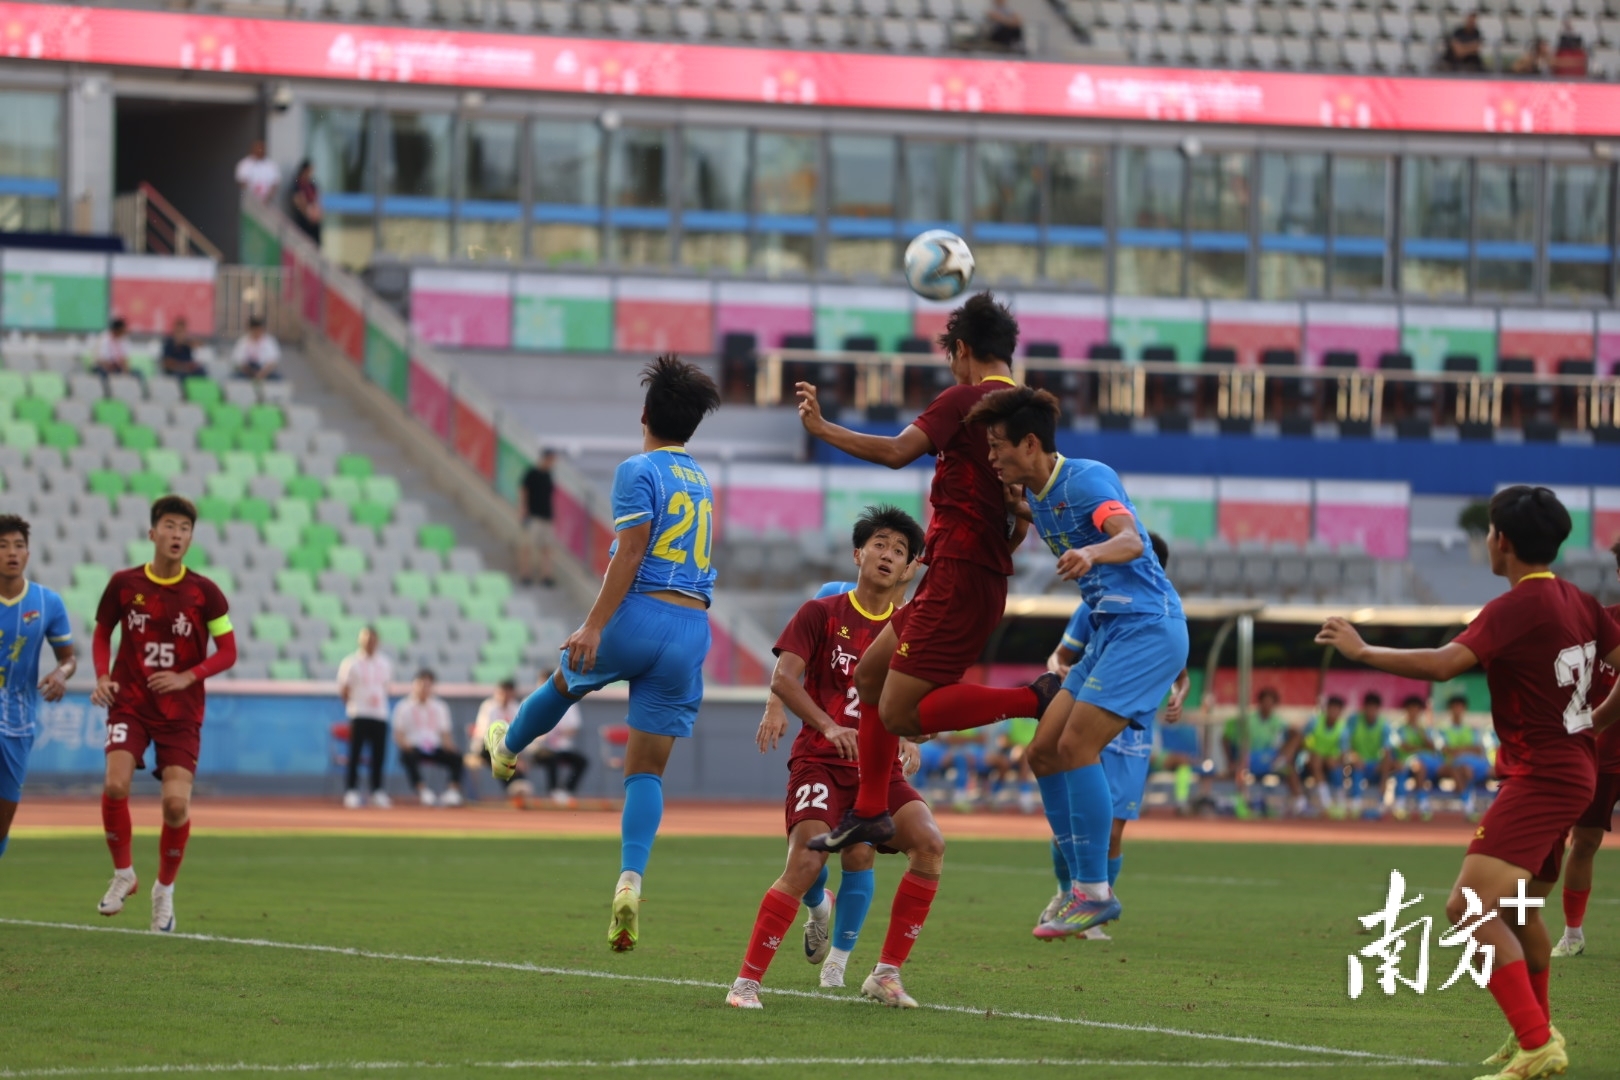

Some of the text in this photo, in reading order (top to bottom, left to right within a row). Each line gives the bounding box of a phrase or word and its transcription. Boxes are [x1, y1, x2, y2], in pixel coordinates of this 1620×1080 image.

[652, 491, 712, 573] 20
[127, 609, 193, 637] 河南
[144, 642, 175, 668] 25
[844, 686, 862, 720] 2
[794, 782, 829, 813] 22
